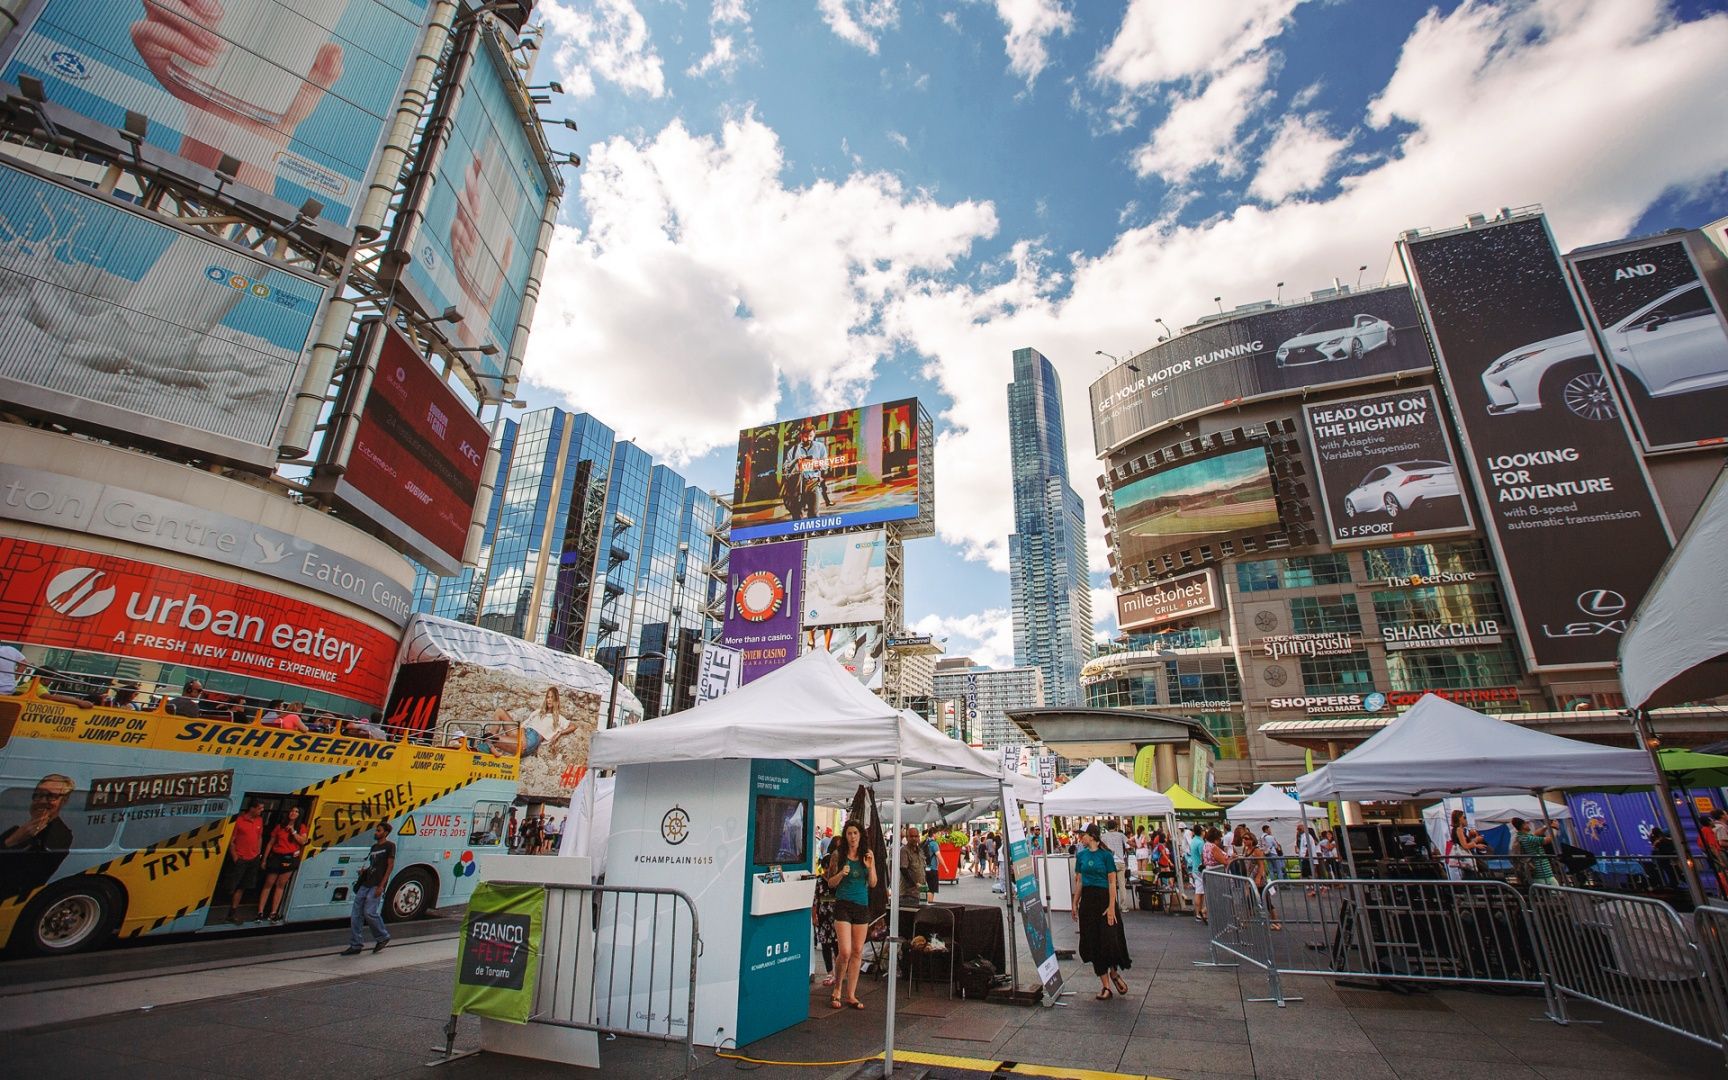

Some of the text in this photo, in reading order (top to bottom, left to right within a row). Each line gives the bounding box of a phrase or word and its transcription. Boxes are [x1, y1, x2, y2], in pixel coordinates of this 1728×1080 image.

[1615, 264, 1657, 280] AND
[1098, 339, 1264, 412] GET YOUR MOTOR RUNNING
[1151, 385, 1170, 398] RC F
[1313, 397, 1427, 425] HEAD OUT ON
[1316, 412, 1426, 438] THE HIGHWAY
[1320, 434, 1386, 451] with Adaptive
[458, 440, 481, 467] KFC
[1322, 441, 1420, 461] Variable Suspension
[1487, 448, 1580, 470] LOOKING
[802, 455, 846, 470] WHEREVER
[1492, 470, 1532, 486] FOR
[404, 480, 433, 505] SUBWAY
[1498, 478, 1614, 502] ADVENTURE
[1504, 501, 1578, 518] with 8-speed
[103, 500, 238, 554] Centre
[793, 516, 842, 532] SAMSUNG
[1508, 510, 1641, 530] automatic transmission
[1338, 522, 1394, 537] IS F SPORT
[302, 552, 410, 620] Eaton Centre
[1124, 583, 1202, 613] milestones
[1154, 598, 1204, 615] GRILL BAR
[125, 590, 363, 674] urban eatery
[1383, 620, 1499, 642] SHARK CLUB
[1542, 620, 1627, 638] LEX
[724, 636, 743, 645] More
[744, 635, 760, 644] than
[768, 633, 793, 641] casino.
[1404, 636, 1482, 648] SPORTS BAR GRILL
[113, 630, 338, 683] A FRESH NEW DINING EXPERIENCE
[762, 648, 786, 659] CASINO
[1270, 695, 1361, 708] SHOPPERS
[1453, 687, 1518, 702] FITNESS
[25, 702, 66, 715] TORONTO
[1181, 700, 1231, 708] milestones
[1335, 704, 1361, 712] MART
[21, 712, 78, 726] CITYGUIDE
[84, 714, 147, 730] JUMP ON
[53, 724, 75, 734] .com
[78, 728, 120, 742] JUMP
[120, 732, 148, 744] OFF
[175, 722, 398, 760] SIGHTSEEING
[412, 751, 446, 762] JUMP ON
[410, 760, 446, 772] JUMP OFF
[334, 780, 414, 832] CENTRE!
[88, 815, 107, 826] THE
[421, 815, 451, 827] JUNE
[453, 816, 462, 827] 5
[419, 828, 466, 838] SEPT 13, 2015
[143, 834, 225, 881] TRY IT
[634, 855, 713, 866] #CHAMPLAIN1615
[472, 922, 523, 944] FRANCO
[476, 966, 510, 978] de Toronto
